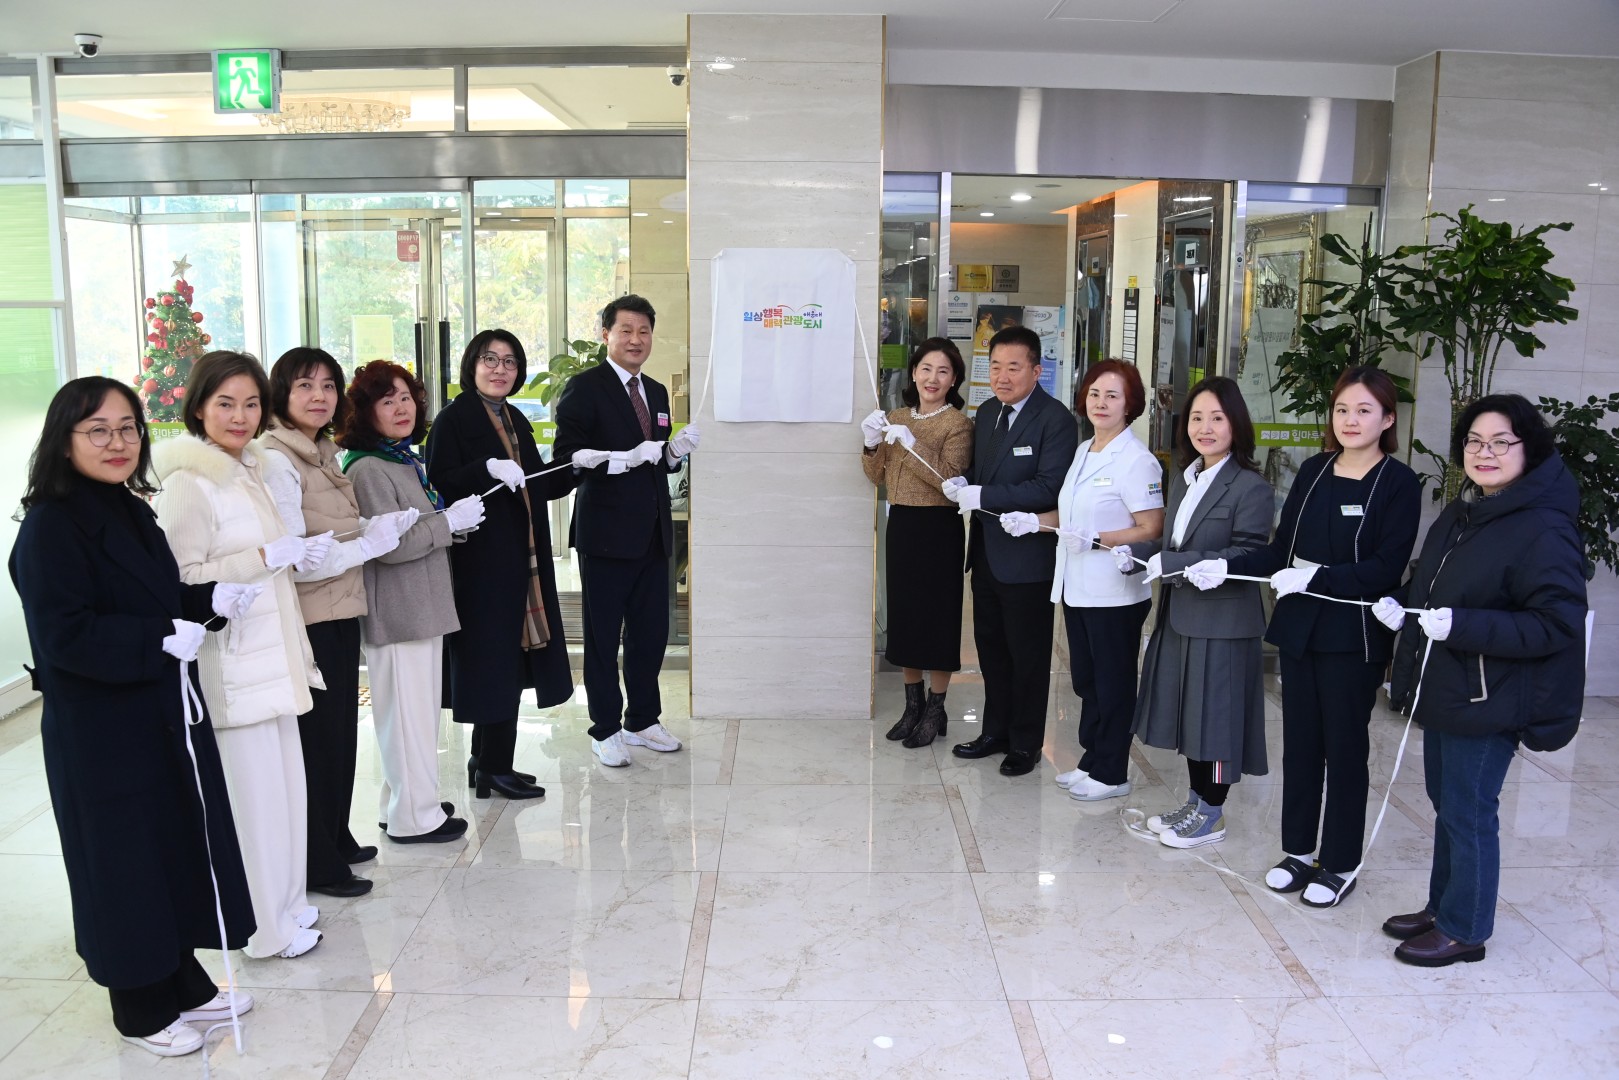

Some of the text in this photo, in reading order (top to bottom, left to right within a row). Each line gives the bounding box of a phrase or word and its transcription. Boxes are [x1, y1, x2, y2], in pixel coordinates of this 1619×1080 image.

[744, 308, 782, 321] 일상 행복
[764, 315, 822, 328] 매력 관광 도시
